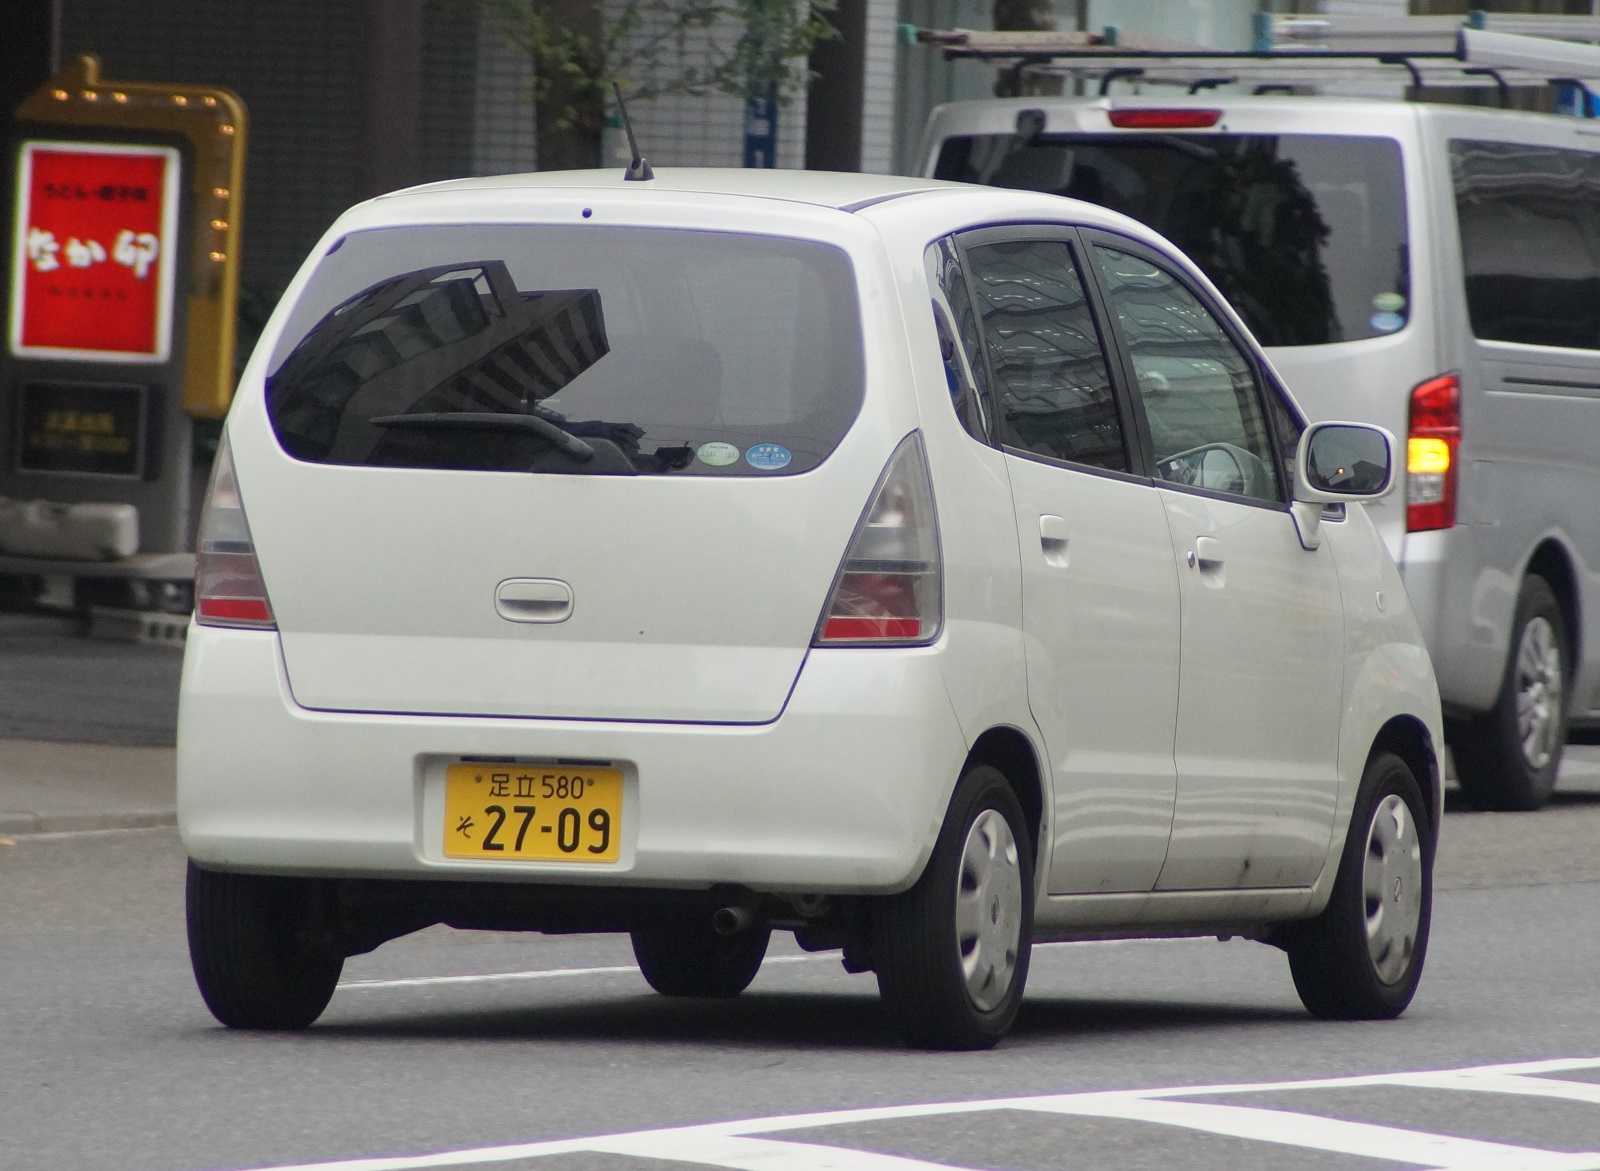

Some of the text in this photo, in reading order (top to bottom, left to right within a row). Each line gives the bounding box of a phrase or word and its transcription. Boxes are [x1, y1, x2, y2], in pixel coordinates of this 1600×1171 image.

[28, 228, 159, 280] なか卯
[489, 773, 584, 799] 足立 580
[456, 805, 610, 854] そ 27-09
